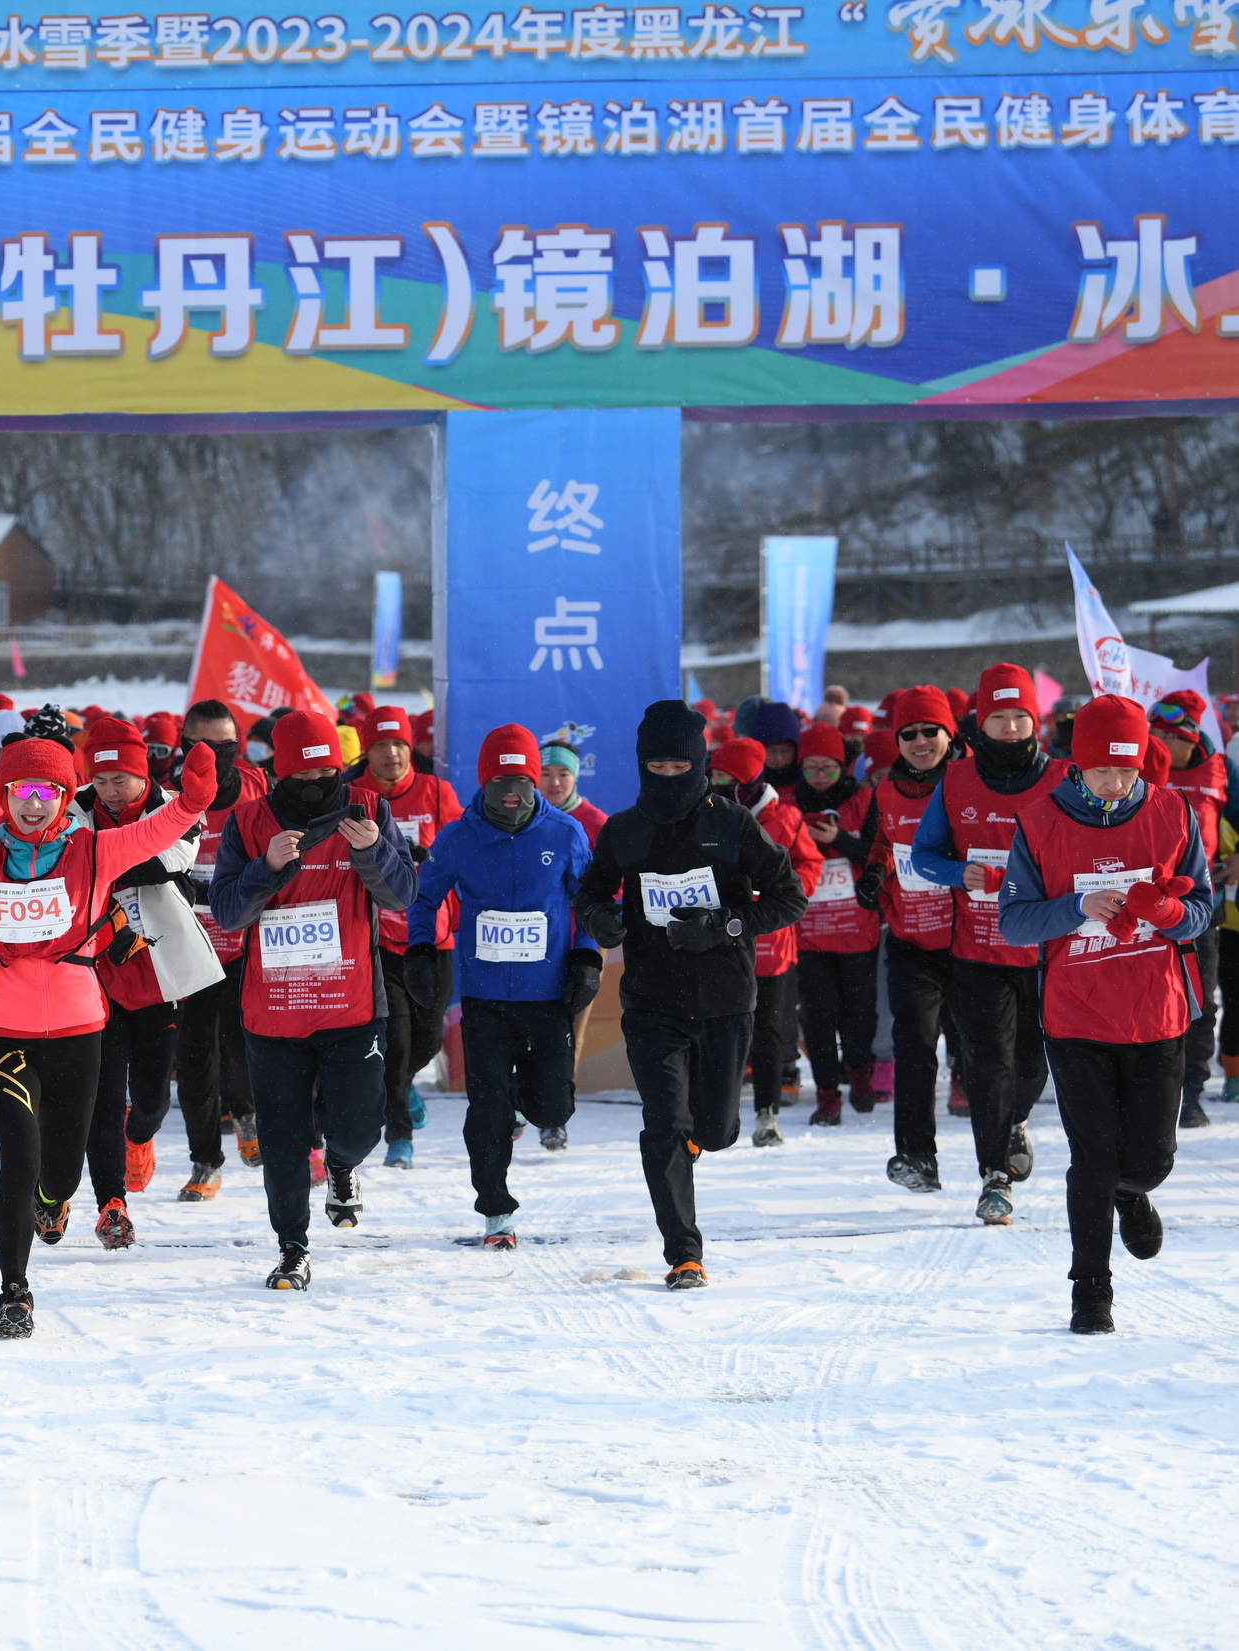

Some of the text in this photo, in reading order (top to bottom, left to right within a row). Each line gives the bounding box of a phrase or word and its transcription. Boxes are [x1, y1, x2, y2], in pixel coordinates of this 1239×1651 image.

[526, 478, 604, 672] 终点
[648, 884, 711, 908] M031
[263, 922, 334, 948] M089
[482, 925, 541, 945] M015
